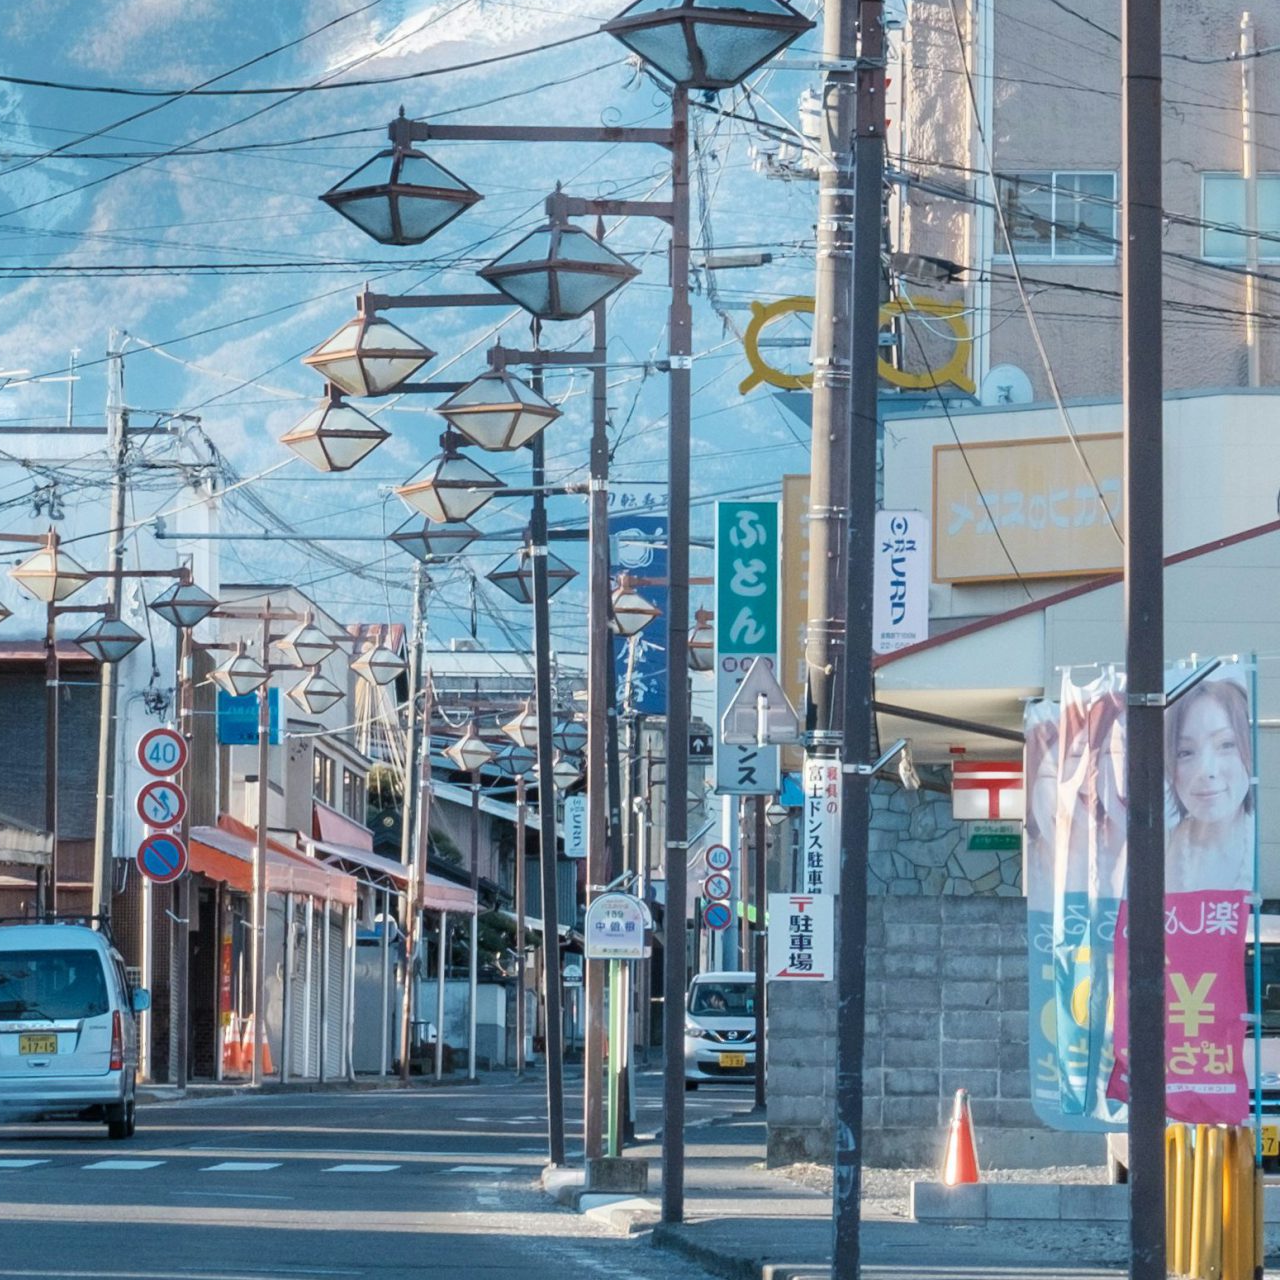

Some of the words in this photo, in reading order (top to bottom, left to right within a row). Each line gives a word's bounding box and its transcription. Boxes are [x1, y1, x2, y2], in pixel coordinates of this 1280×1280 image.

[729, 510, 767, 645] ふとん
[149, 742, 176, 763] 40
[711, 851, 726, 864] 40
[789, 915, 814, 971] 駐車場
